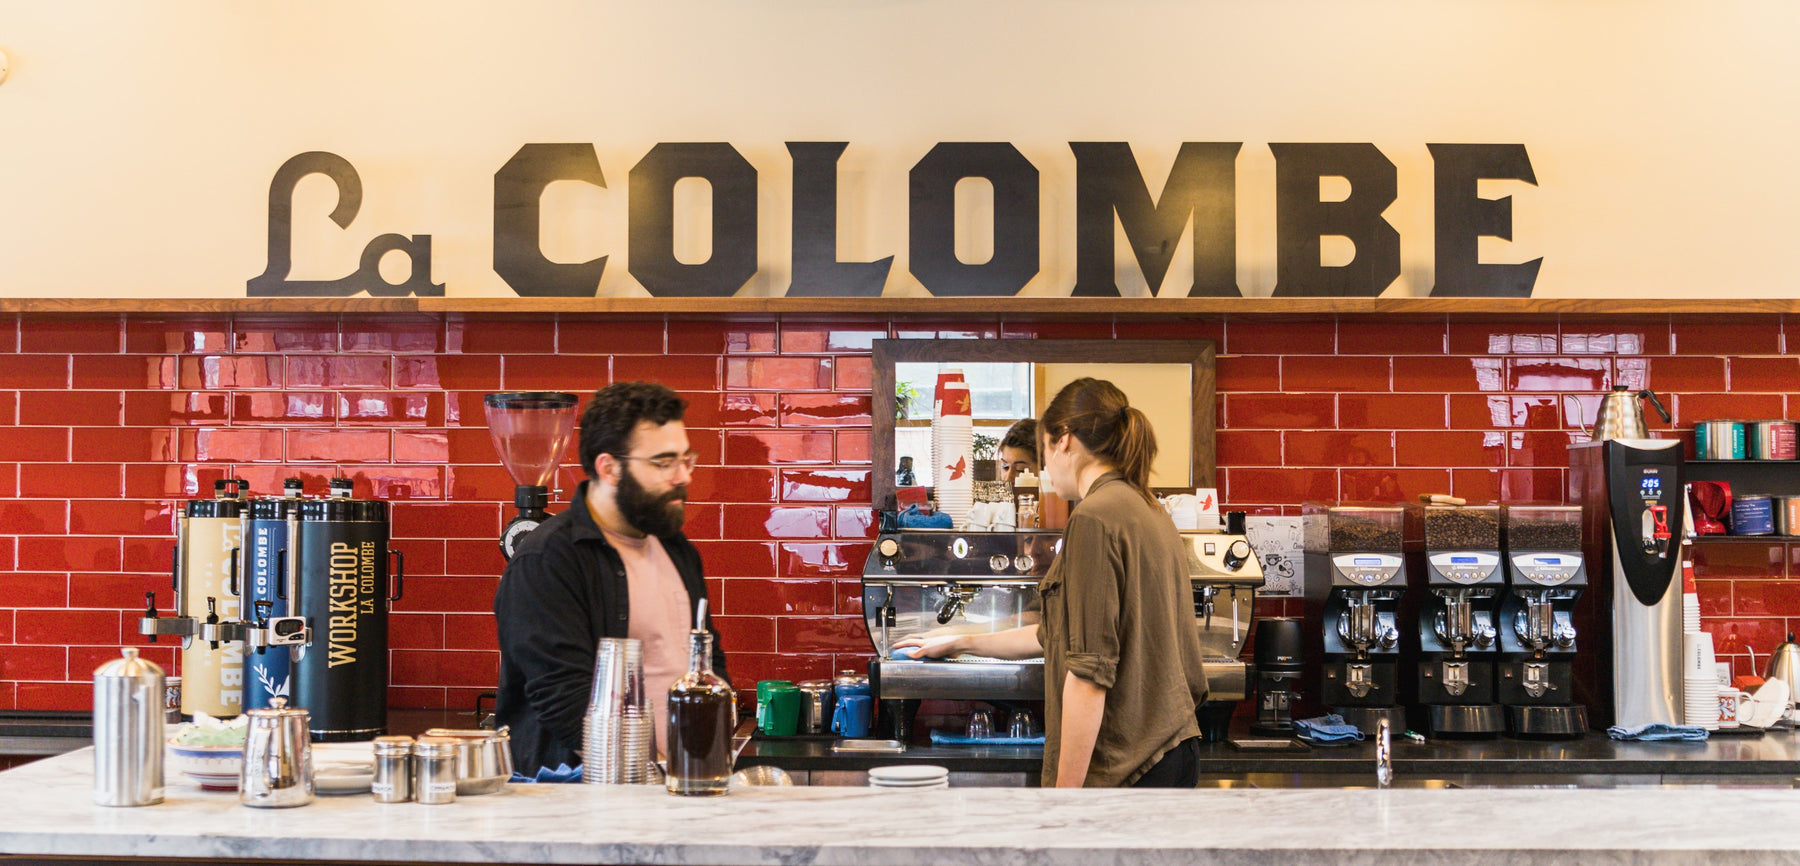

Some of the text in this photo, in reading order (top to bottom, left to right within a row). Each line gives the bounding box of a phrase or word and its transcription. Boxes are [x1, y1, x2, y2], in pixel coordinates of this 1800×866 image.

[246, 141, 1544, 298] La COLOMBE
[1642, 479, 1659, 488] 205
[257, 527, 268, 594] COLOMBE
[361, 541, 375, 614] LA COLOMBE
[328, 542, 359, 669] WORKSHOP
